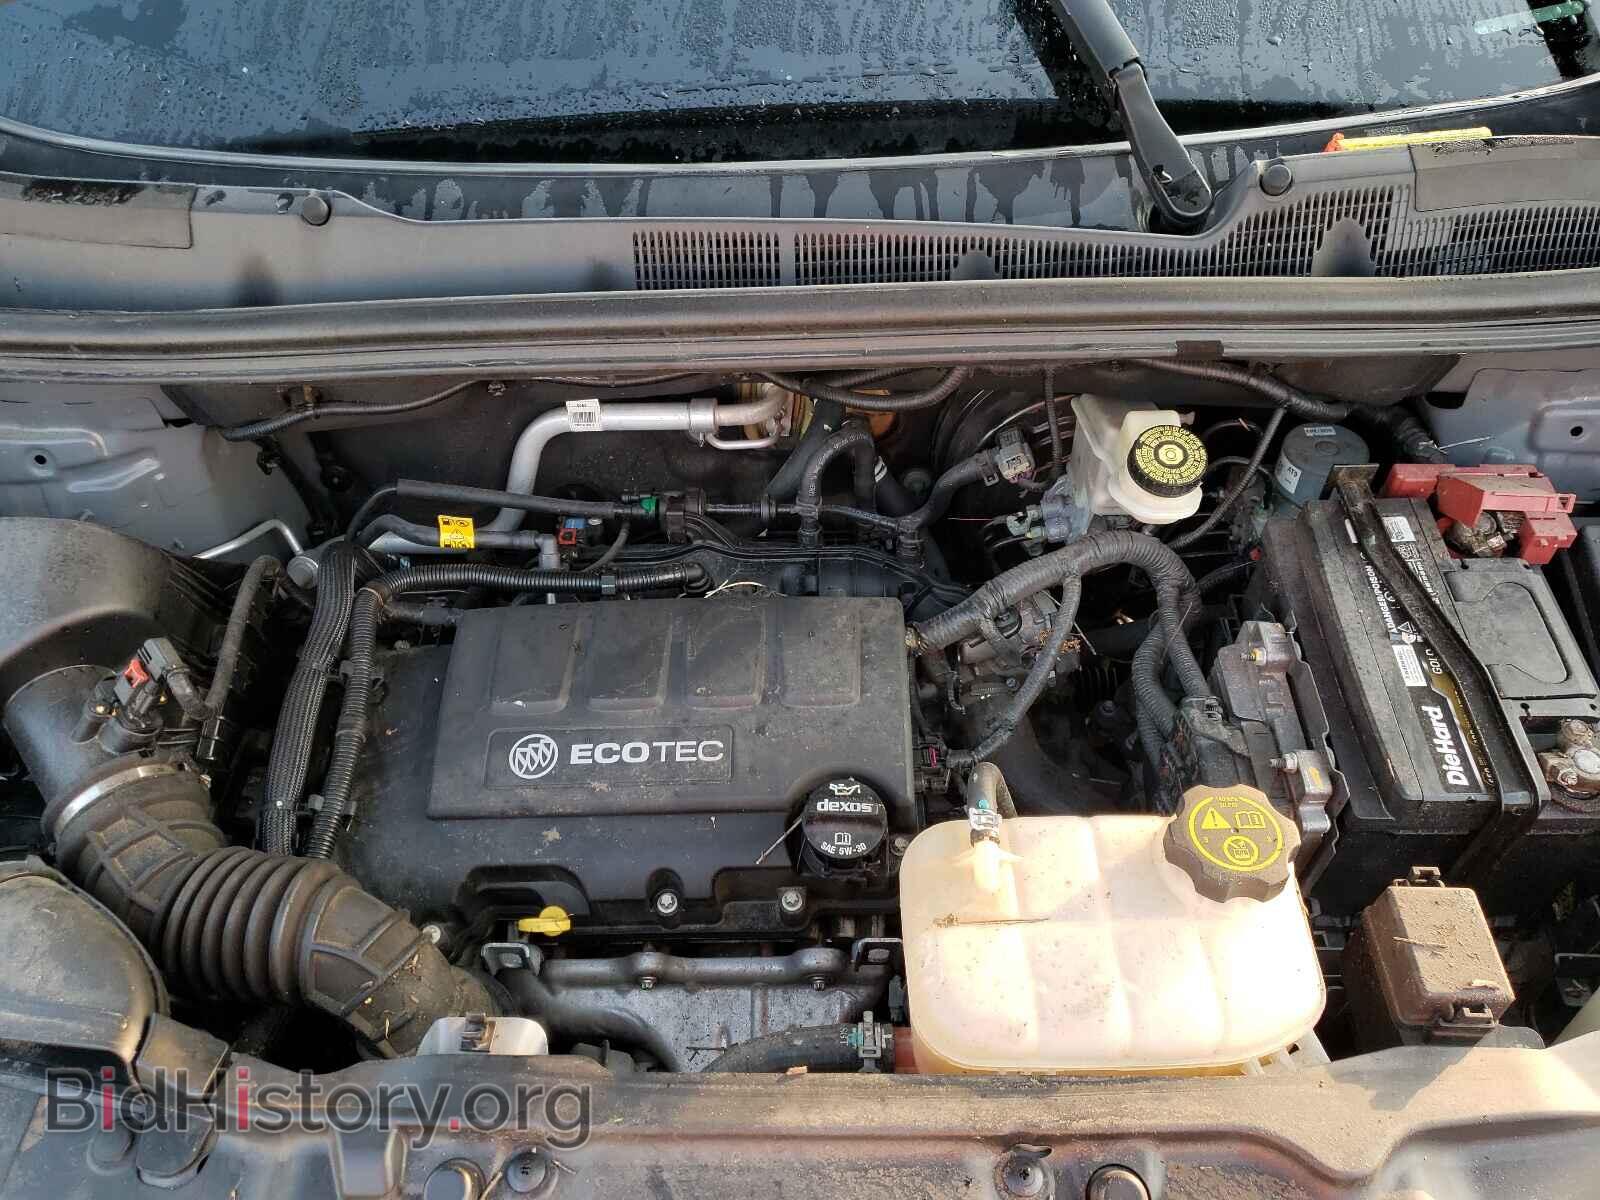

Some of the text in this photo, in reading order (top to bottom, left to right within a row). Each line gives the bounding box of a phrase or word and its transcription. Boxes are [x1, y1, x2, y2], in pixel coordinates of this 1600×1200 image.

[570, 740, 724, 765] ECOTEC
[1421, 705, 1470, 786] DieHard
[816, 798, 873, 813] dexos
[820, 841, 867, 856] SAE 5W-30
